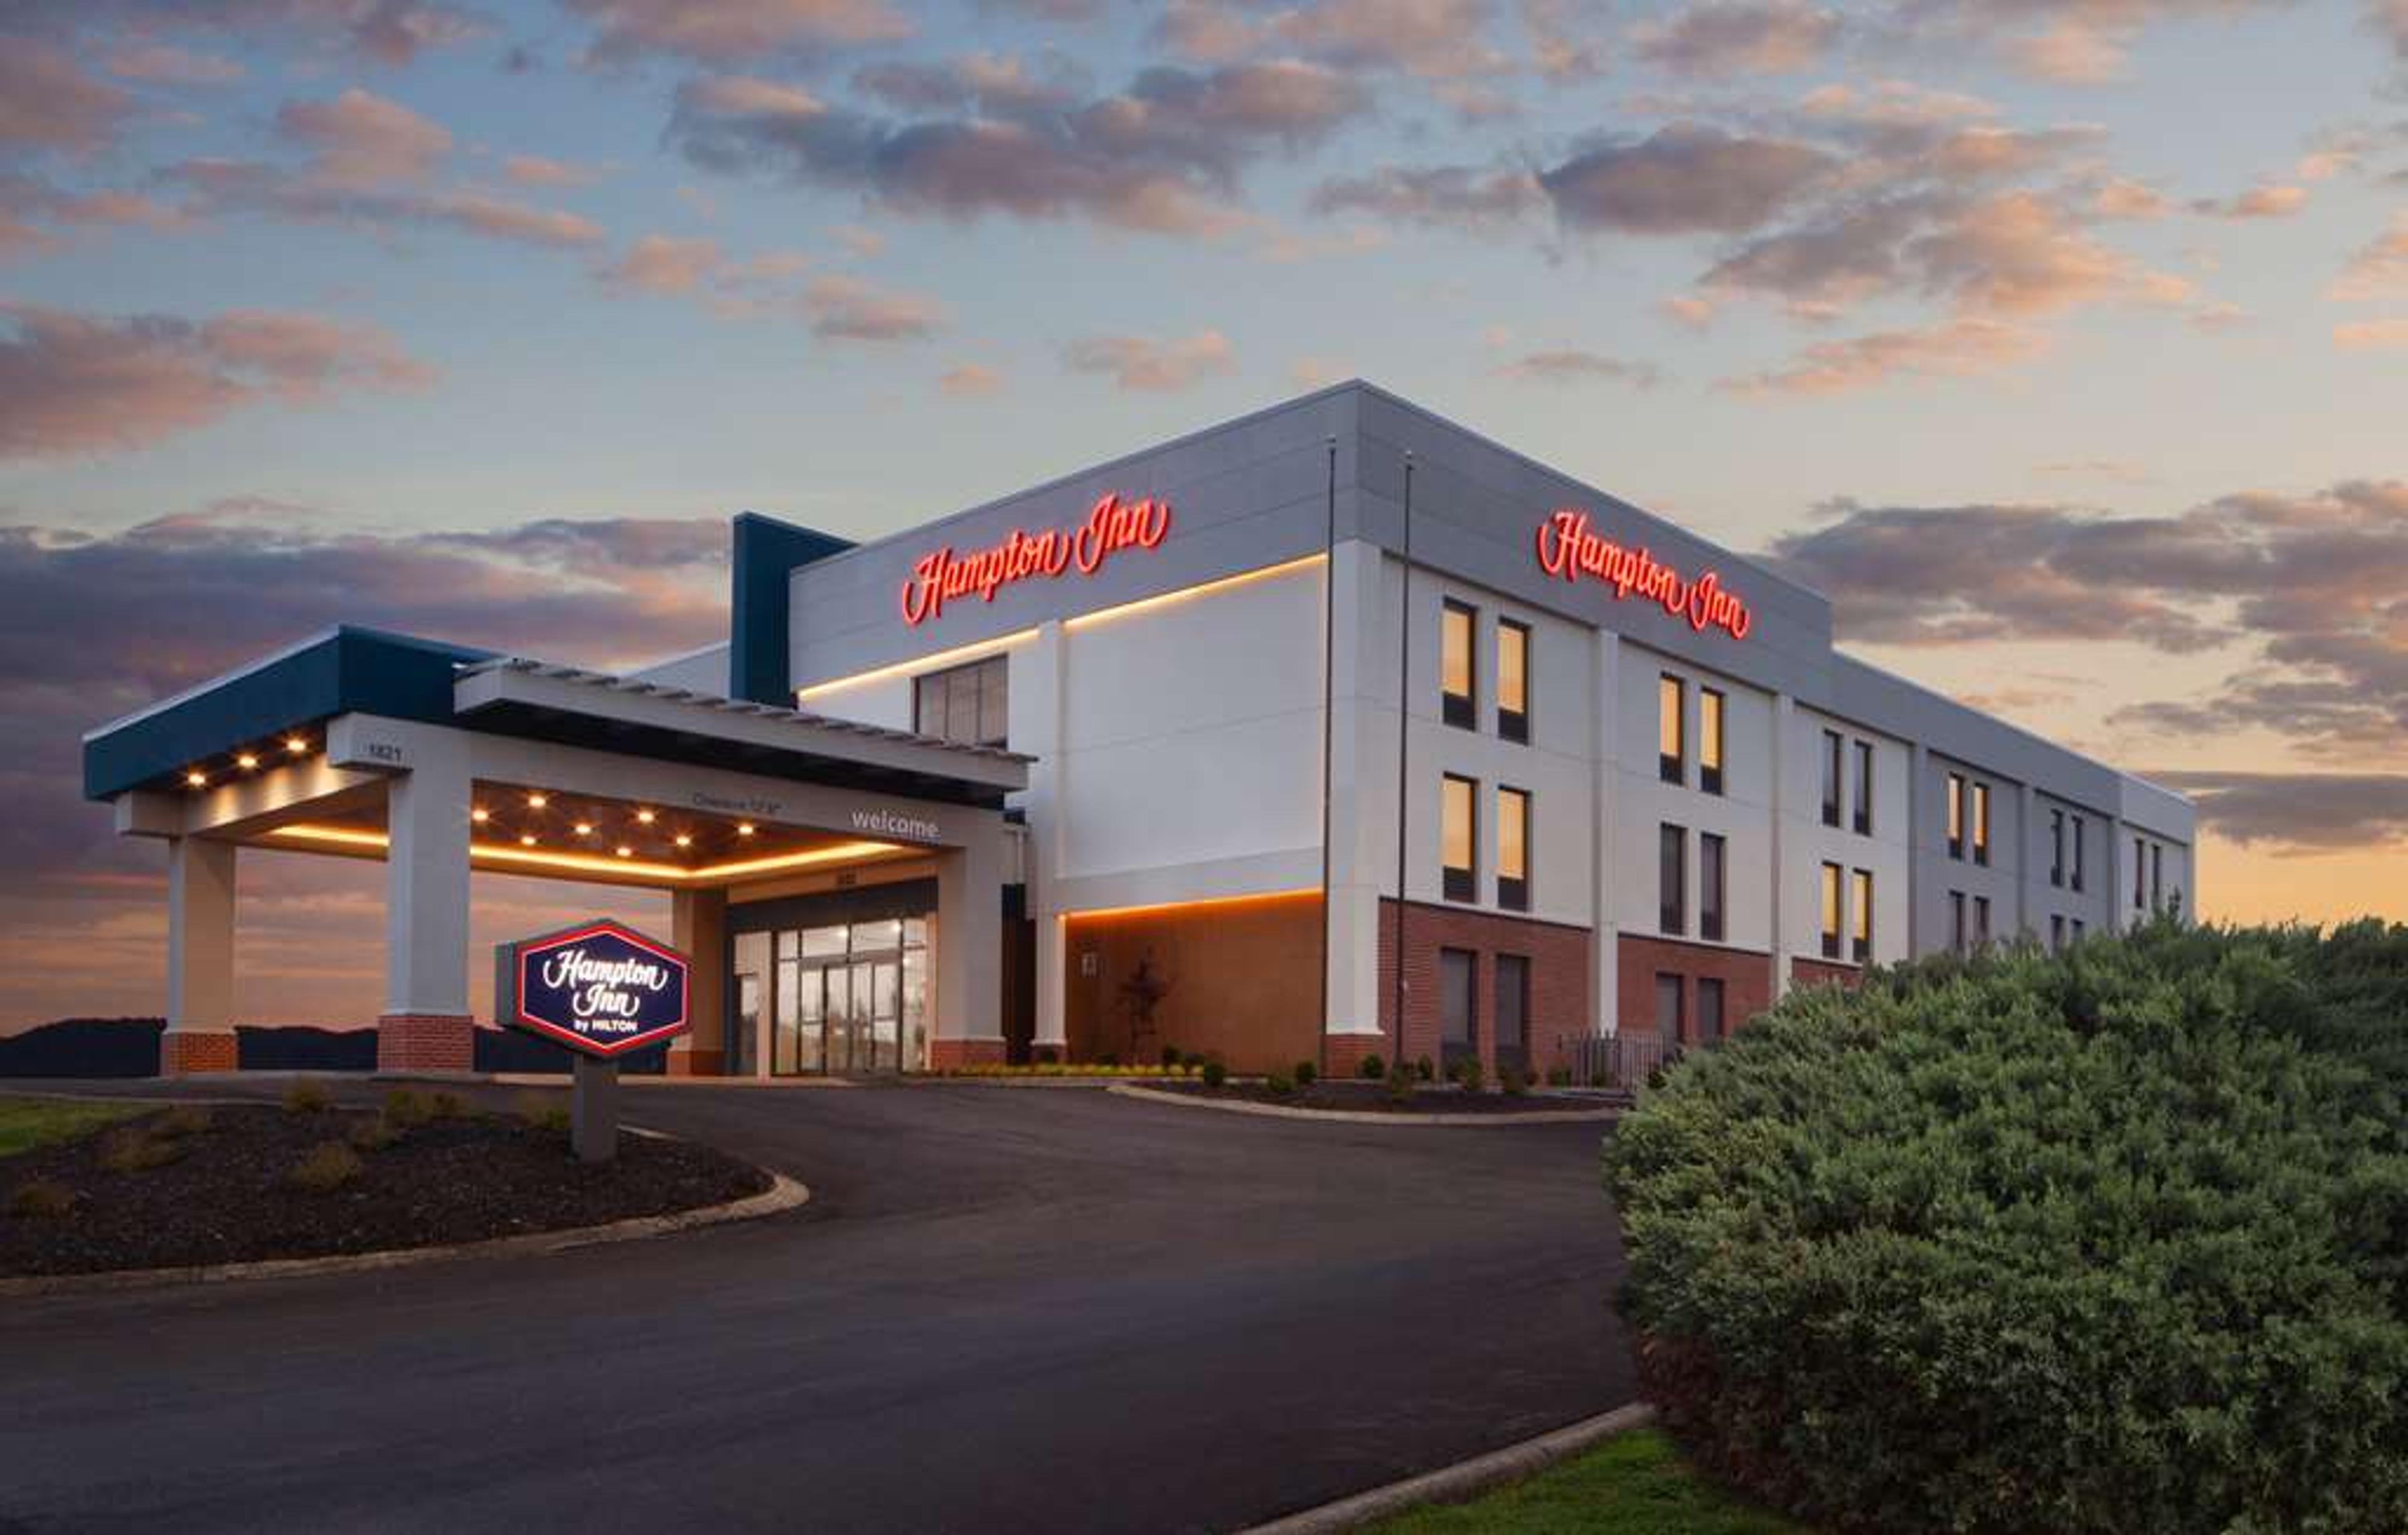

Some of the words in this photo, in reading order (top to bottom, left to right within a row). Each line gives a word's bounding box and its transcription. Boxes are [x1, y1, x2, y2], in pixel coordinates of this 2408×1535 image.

[902, 528, 1070, 626] Hampton
[1075, 493, 1170, 574] Inn
[1538, 511, 1687, 615] Hampton
[1690, 571, 1751, 639] Inn
[852, 810, 941, 839] welcome
[542, 949, 669, 991] Hampton
[573, 983, 640, 1016] Inn
[592, 1020, 638, 1031] HILTON
